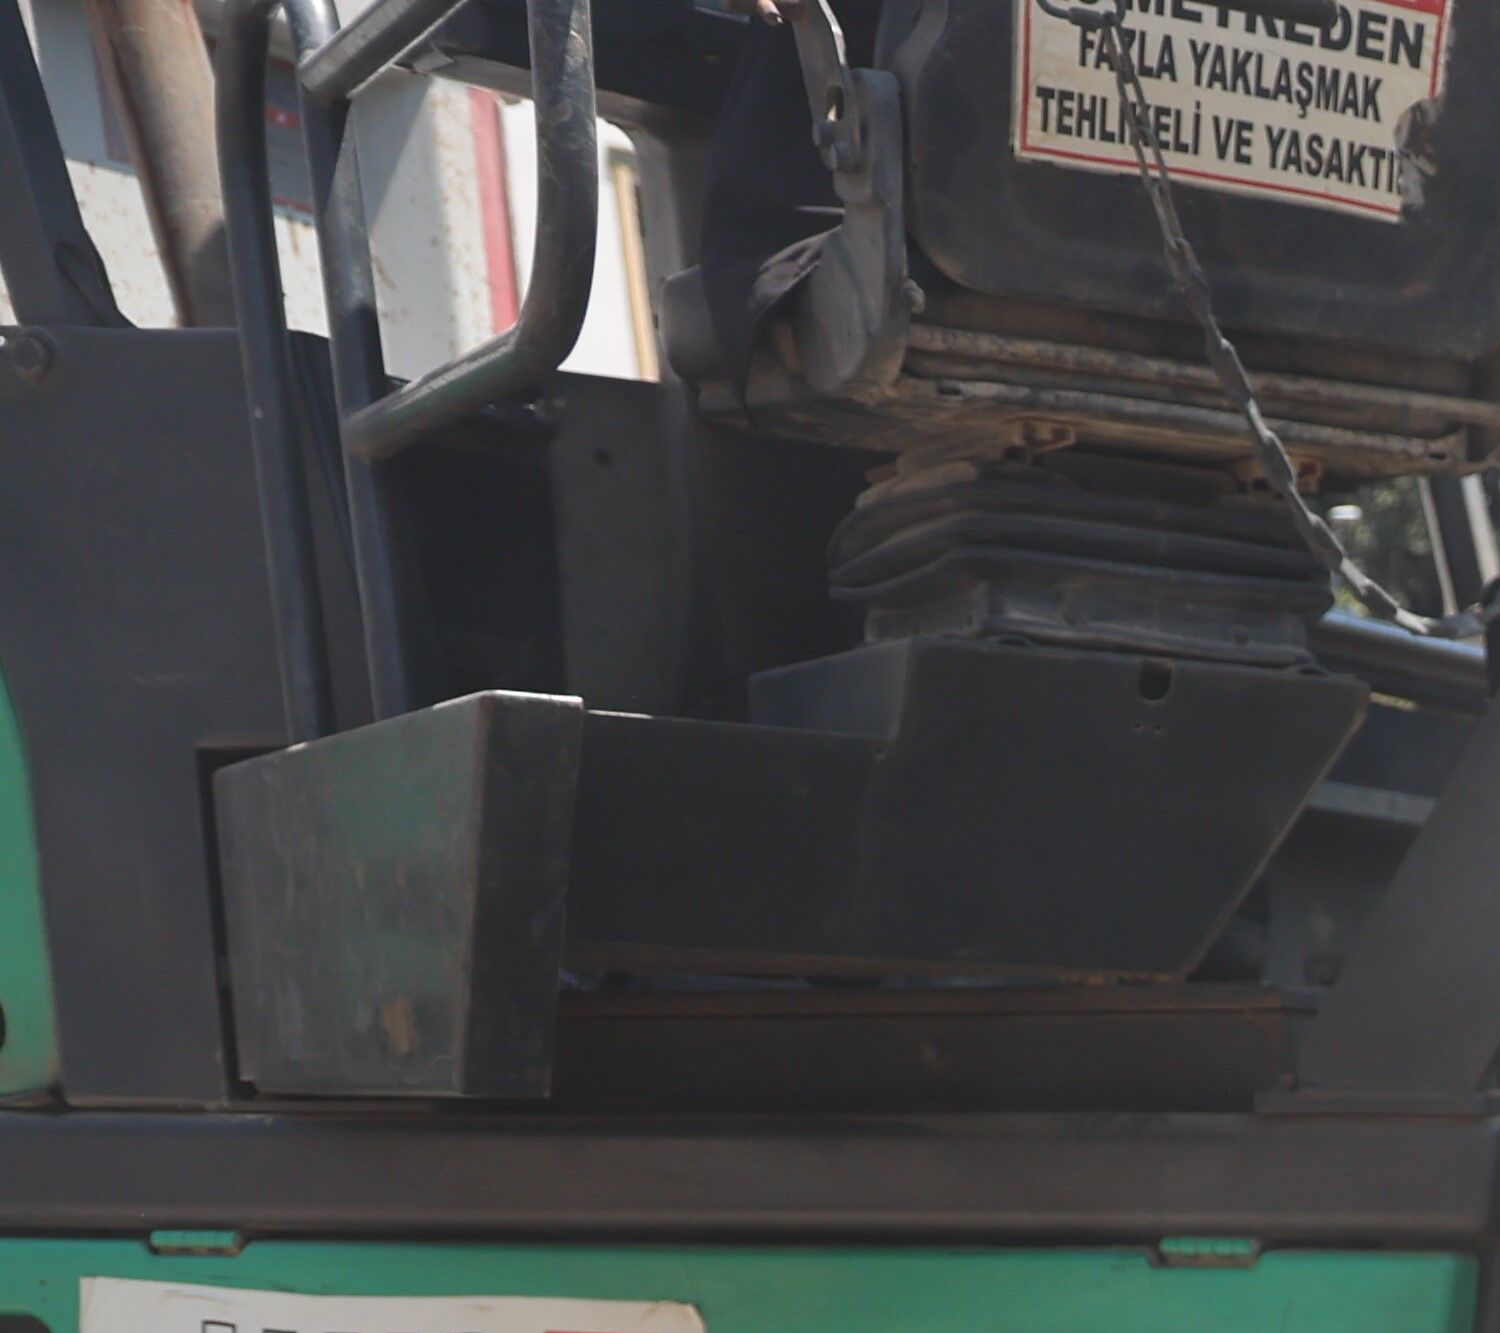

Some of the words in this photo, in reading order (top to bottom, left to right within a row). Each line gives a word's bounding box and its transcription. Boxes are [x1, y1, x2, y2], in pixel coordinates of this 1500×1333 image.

[1188, 38, 1382, 122] YAKLAŞMAK
[1036, 86, 1200, 155] TEHLELİ
[1212, 116, 1252, 165] VE
[1265, 125, 1402, 195] YASAKTI
